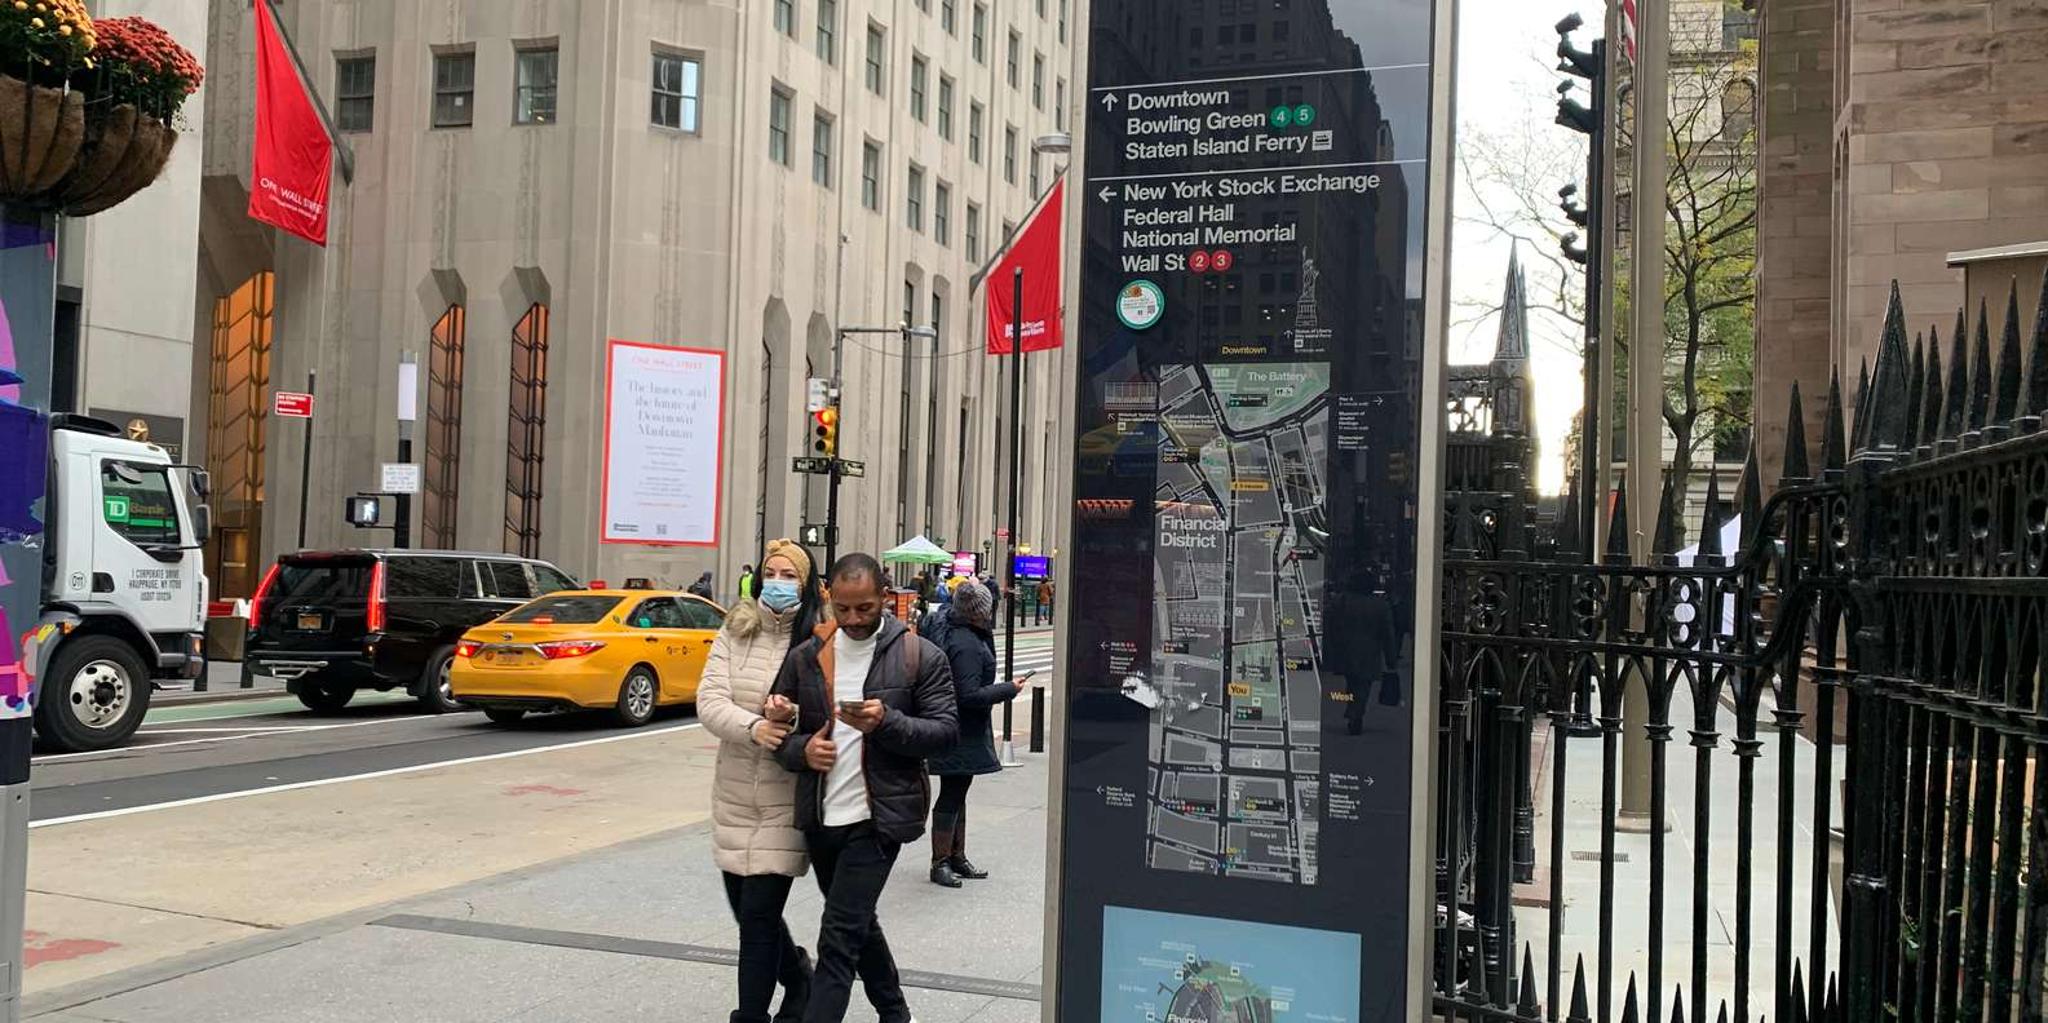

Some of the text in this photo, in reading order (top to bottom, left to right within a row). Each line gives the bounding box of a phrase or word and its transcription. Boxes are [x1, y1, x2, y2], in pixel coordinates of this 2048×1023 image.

[1128, 89, 1230, 110] Downtown
[1127, 115, 1201, 136] Bowling
[1207, 111, 1265, 130] Green
[1125, 134, 1308, 160] Staten Island Ferry
[1124, 174, 1381, 202] New York Stock Exchange
[1124, 204, 1234, 226] Federal Hall
[1123, 224, 1296, 248] National Memorial
[1122, 254, 1159, 273] Wall
[1164, 253, 1185, 271] St
[1221, 346, 1267, 355] Downtown
[1248, 371, 1305, 383] The Battery
[1161, 515, 1229, 532] Financial
[1160, 533, 1217, 548] District
[1230, 684, 1248, 696] You
[1330, 692, 1355, 702] West
